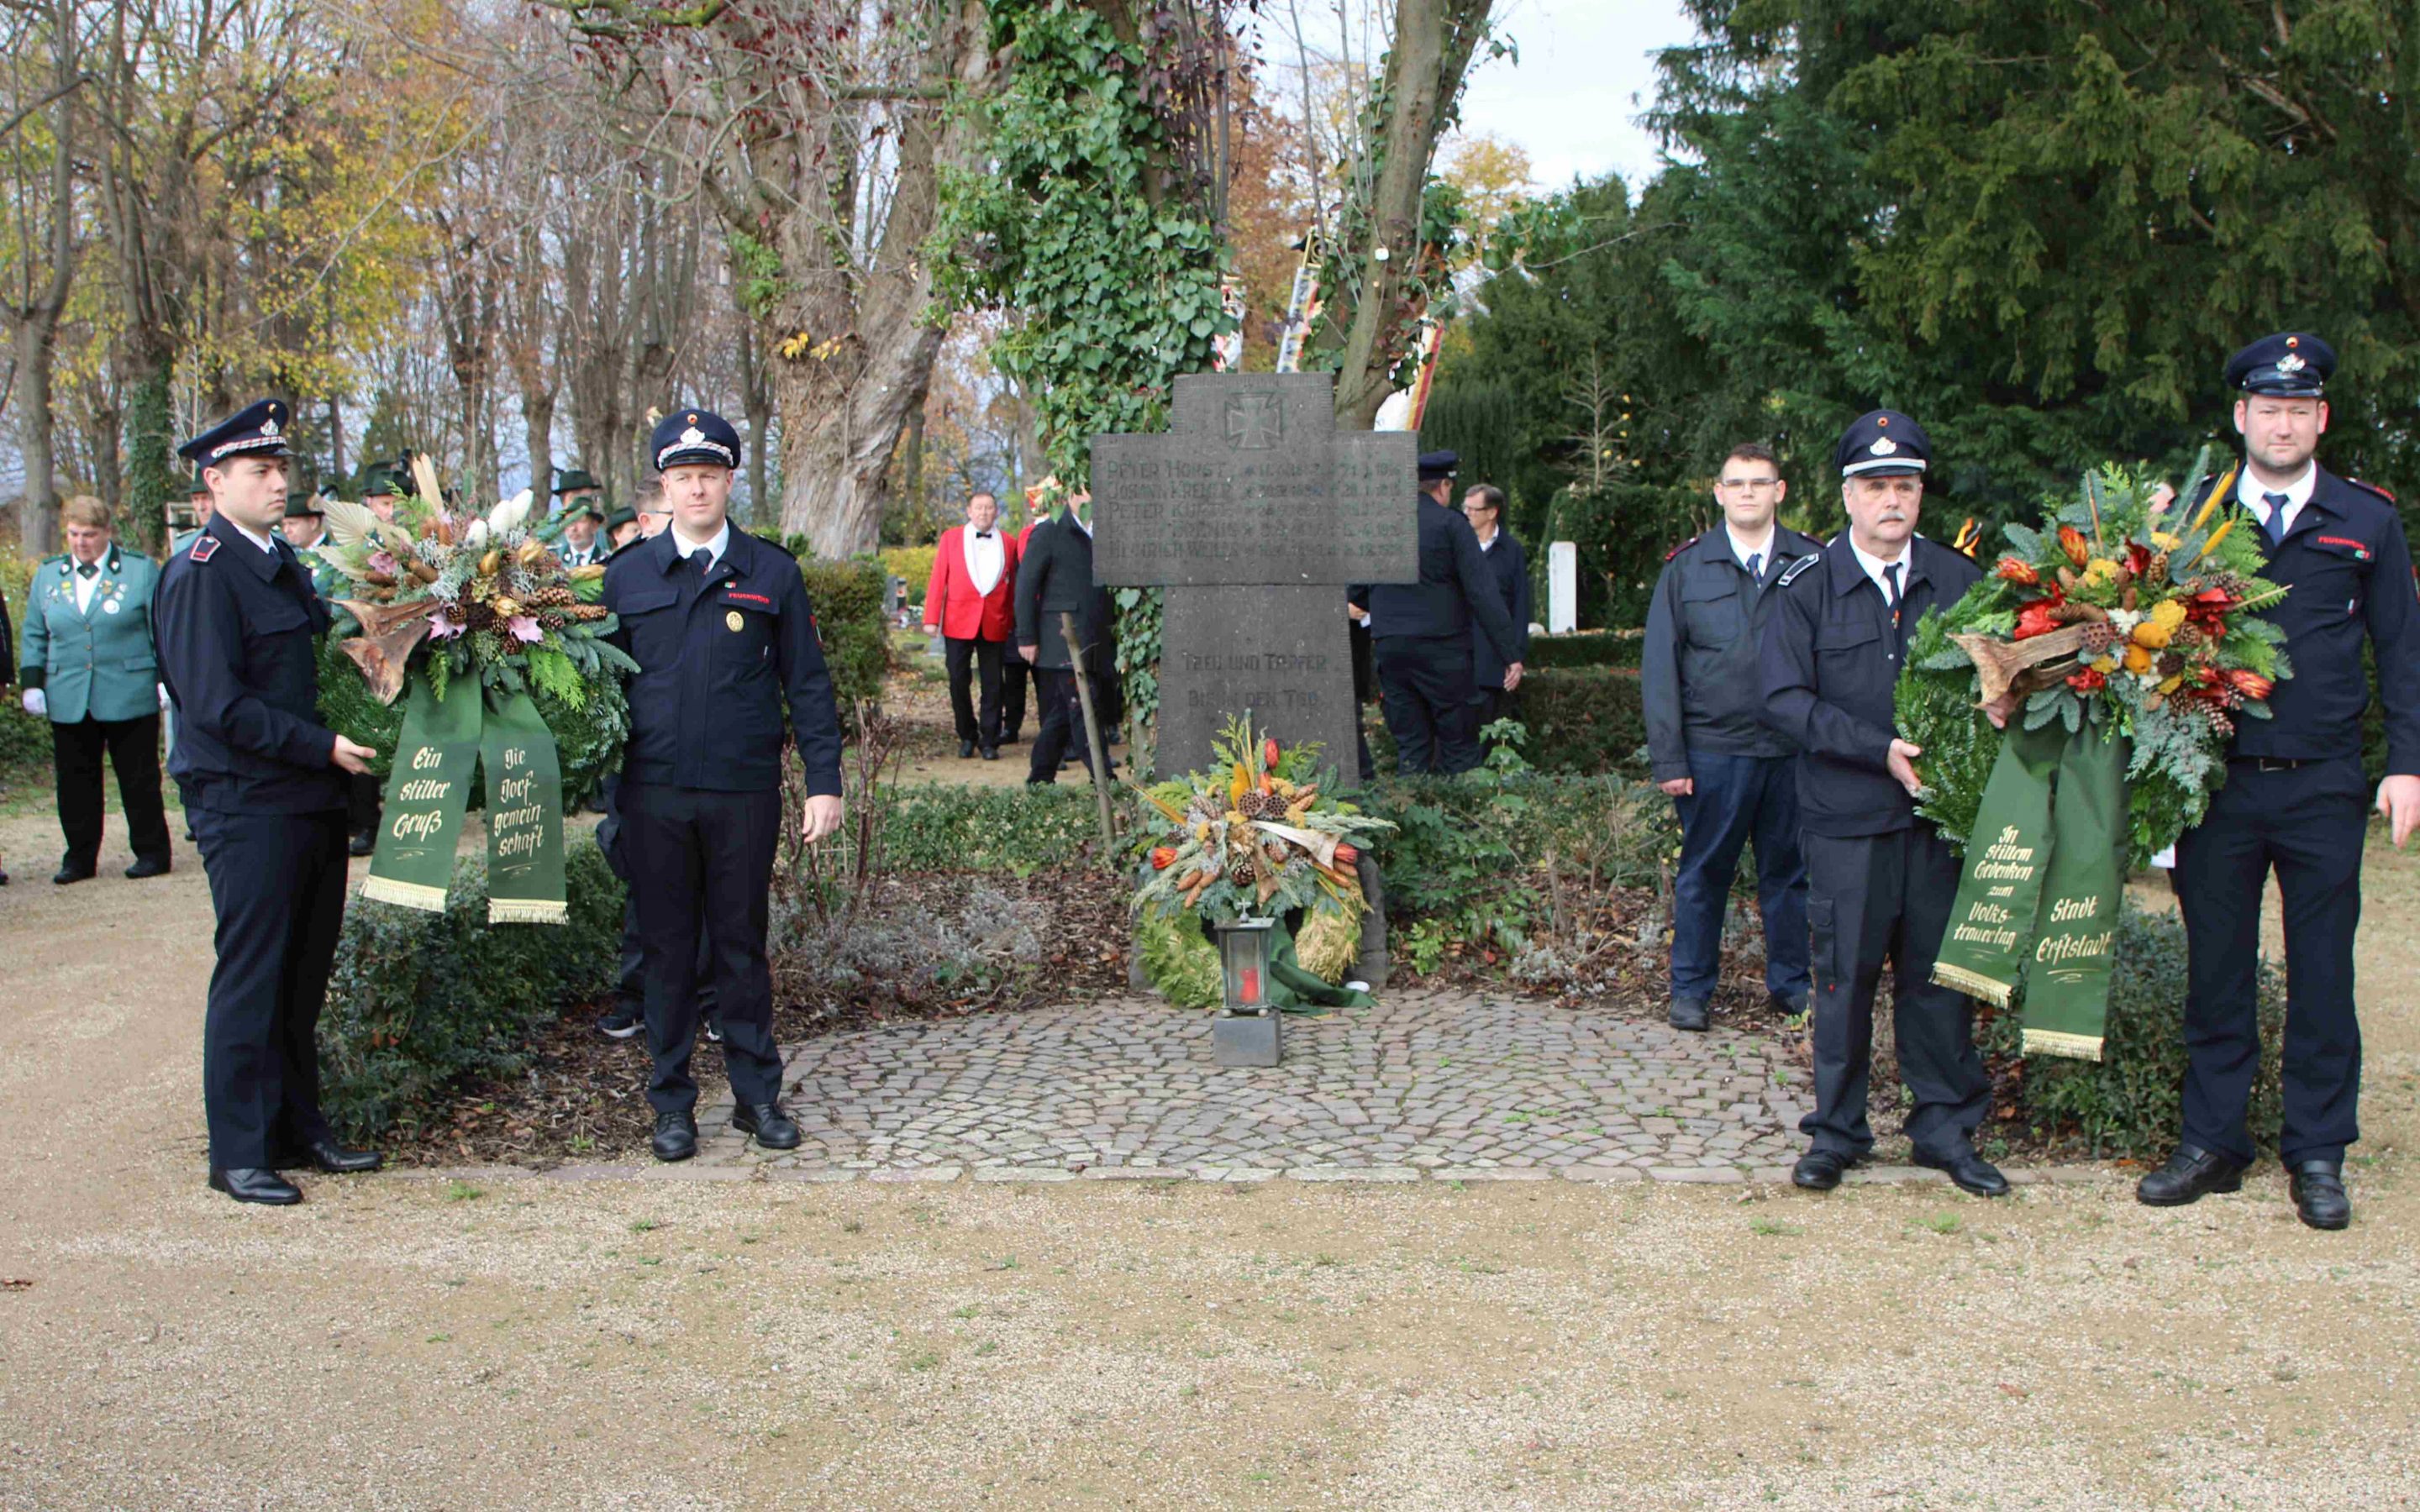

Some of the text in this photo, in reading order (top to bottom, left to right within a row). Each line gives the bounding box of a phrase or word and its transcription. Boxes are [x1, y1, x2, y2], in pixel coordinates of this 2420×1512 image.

[412, 746, 442, 769] Ein
[505, 748, 526, 770] Die
[399, 779, 451, 801] stiller
[392, 810, 443, 842] Gruß
[1998, 824, 2020, 844] In
[498, 825, 544, 858] schaft
[1984, 843, 2033, 863] stillem
[1974, 859, 2034, 881] Gedenken
[1986, 885, 2015, 898] zum
[1968, 900, 2014, 924] Volks-
[2050, 895, 2097, 922] Stadt
[1953, 922, 2017, 953] trauertag
[2035, 932, 2112, 965] Erftstadt
